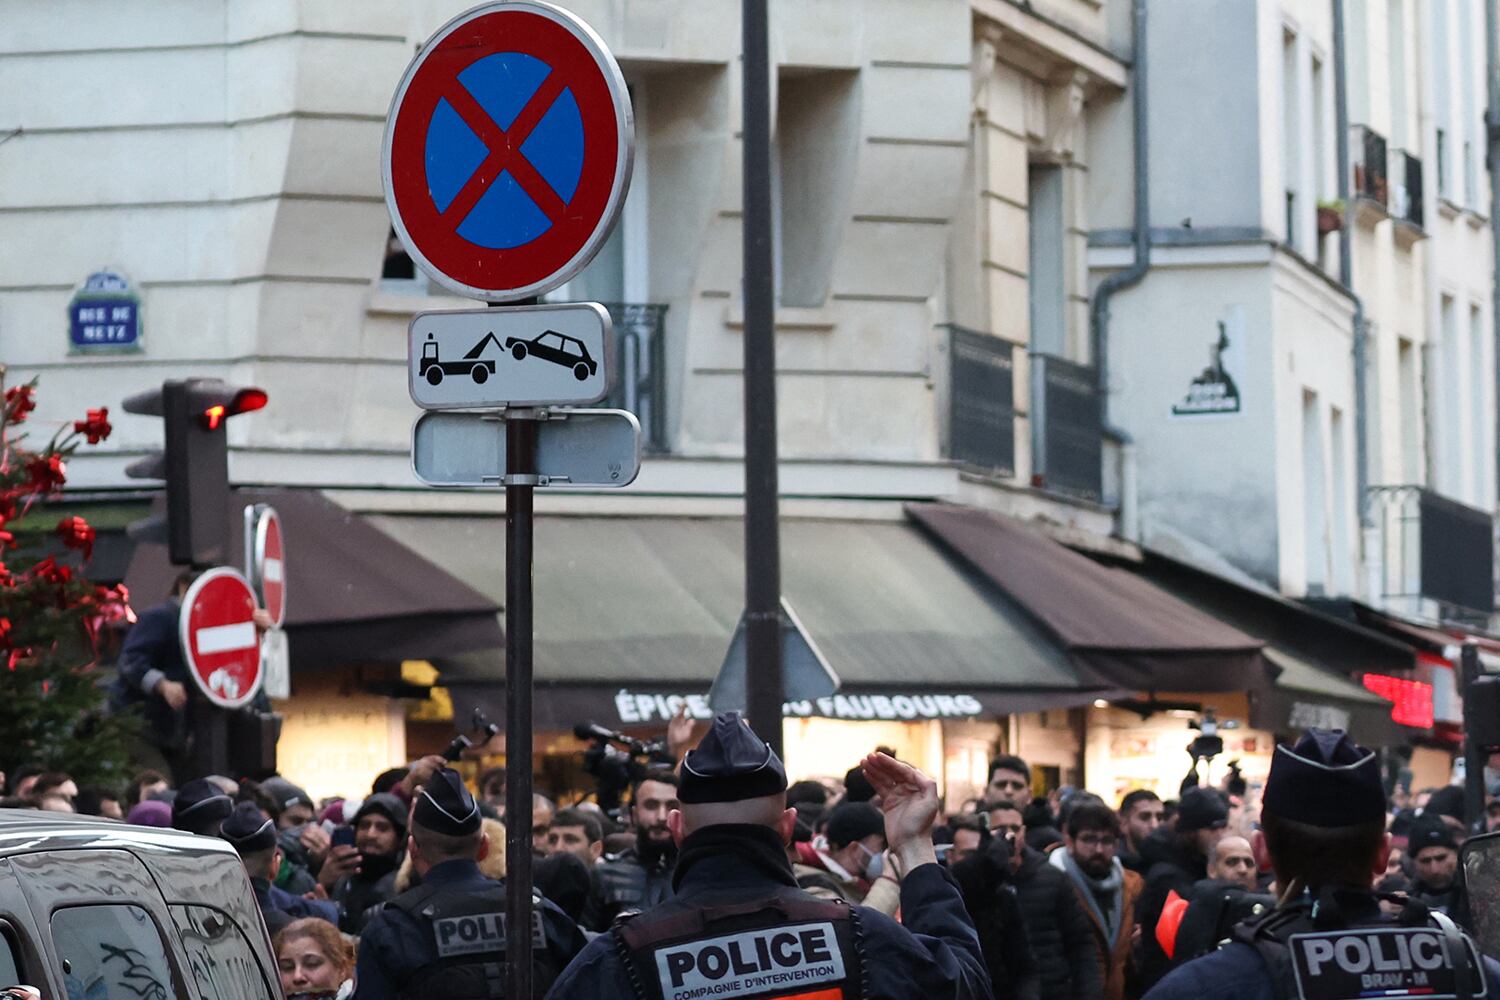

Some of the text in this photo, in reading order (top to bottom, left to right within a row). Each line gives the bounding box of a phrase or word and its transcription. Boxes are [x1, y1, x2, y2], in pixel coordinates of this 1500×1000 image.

[84, 325, 125, 339] METZ
[614, 688, 713, 722] ÉPICE
[818, 694, 983, 719] FAUBOURG
[666, 929, 832, 988] POLICE
[745, 965, 835, 988] D'INTERVENTION
